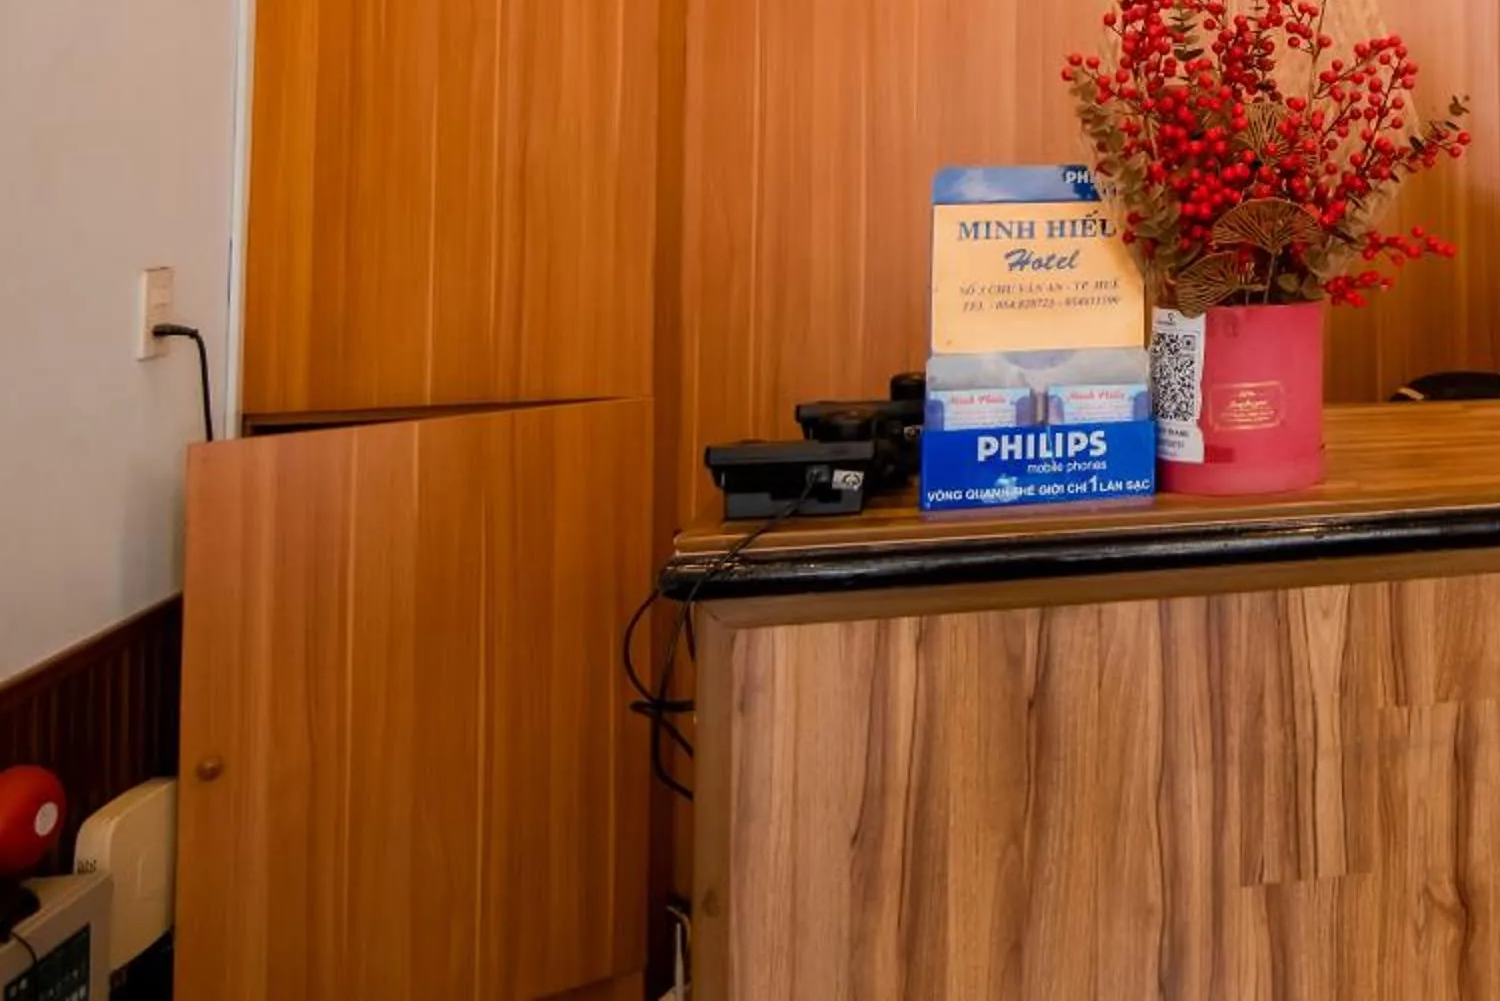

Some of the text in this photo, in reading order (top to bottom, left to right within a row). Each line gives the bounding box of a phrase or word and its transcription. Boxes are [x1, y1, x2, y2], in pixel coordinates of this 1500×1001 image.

[957, 219, 1036, 240] MINH
[1004, 248, 1080, 271] Hotel
[976, 430, 1108, 462] PHILIPS
[1026, 459, 1107, 474] mobile phones
[1089, 474, 1098, 492] 1
